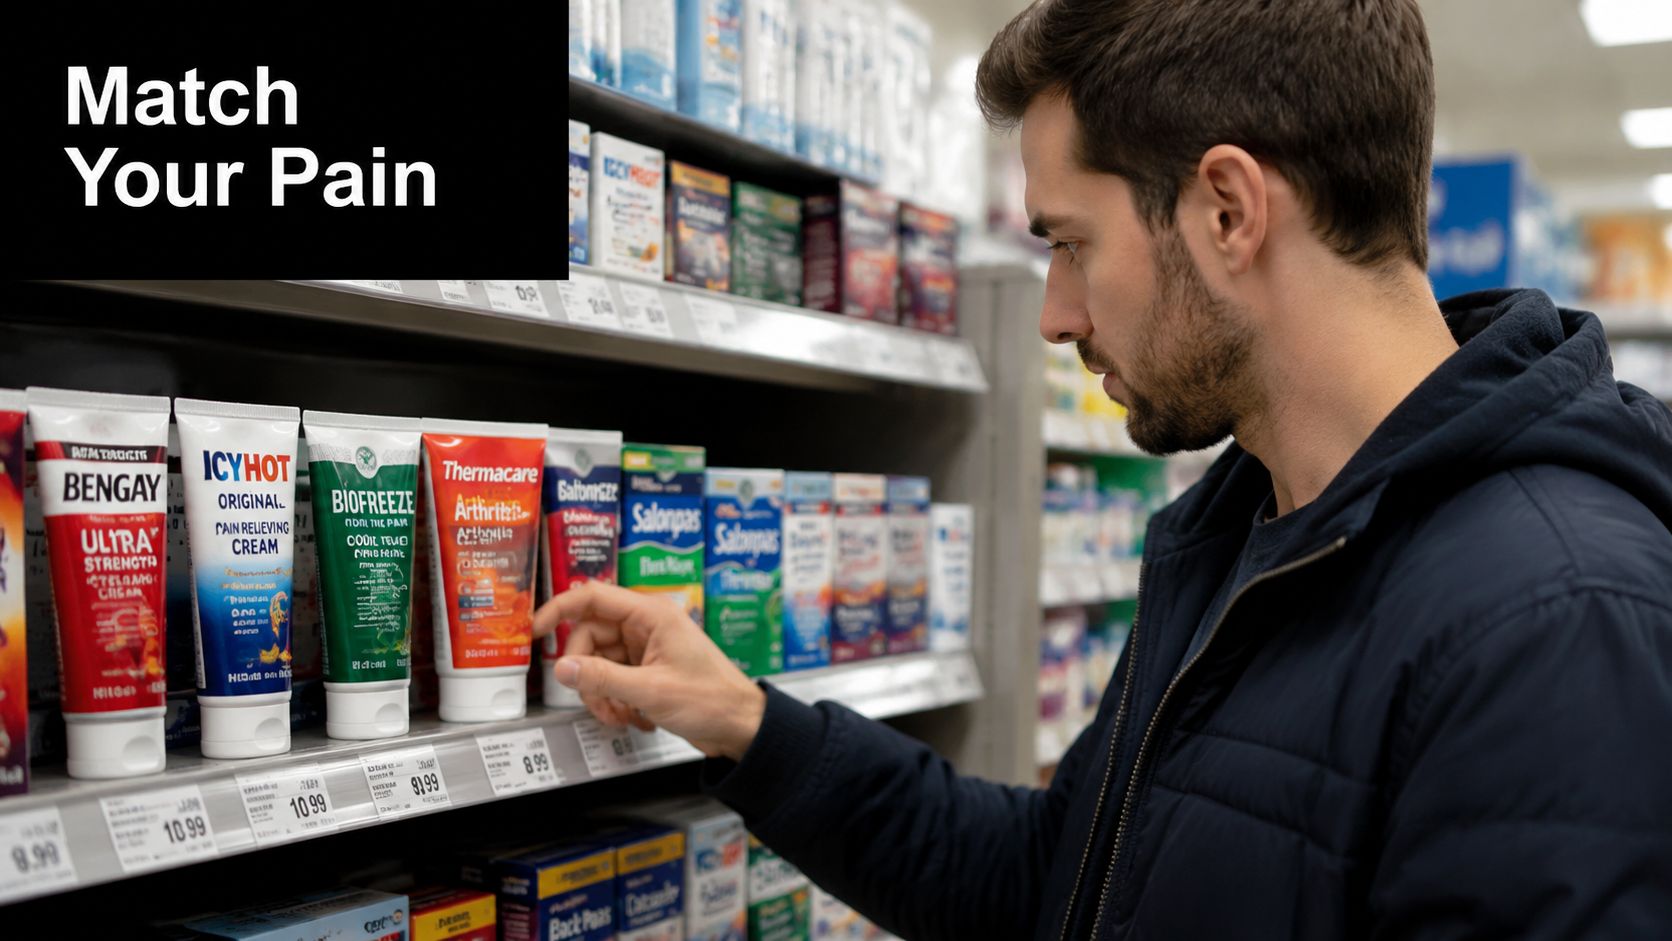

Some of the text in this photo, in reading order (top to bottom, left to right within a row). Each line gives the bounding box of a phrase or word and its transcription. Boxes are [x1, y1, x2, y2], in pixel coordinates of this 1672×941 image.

[203, 450, 290, 482] ICYHOT
[443, 461, 539, 483] Thermacare
[63, 472, 161, 502] BENGAY
[331, 489, 415, 515] BIOFREEZE
[241, 521, 289, 535] RELIEVING
[631, 502, 701, 539] Salonpas
[81, 528, 153, 554] ULTRA
[232, 538, 279, 555] CREAM
